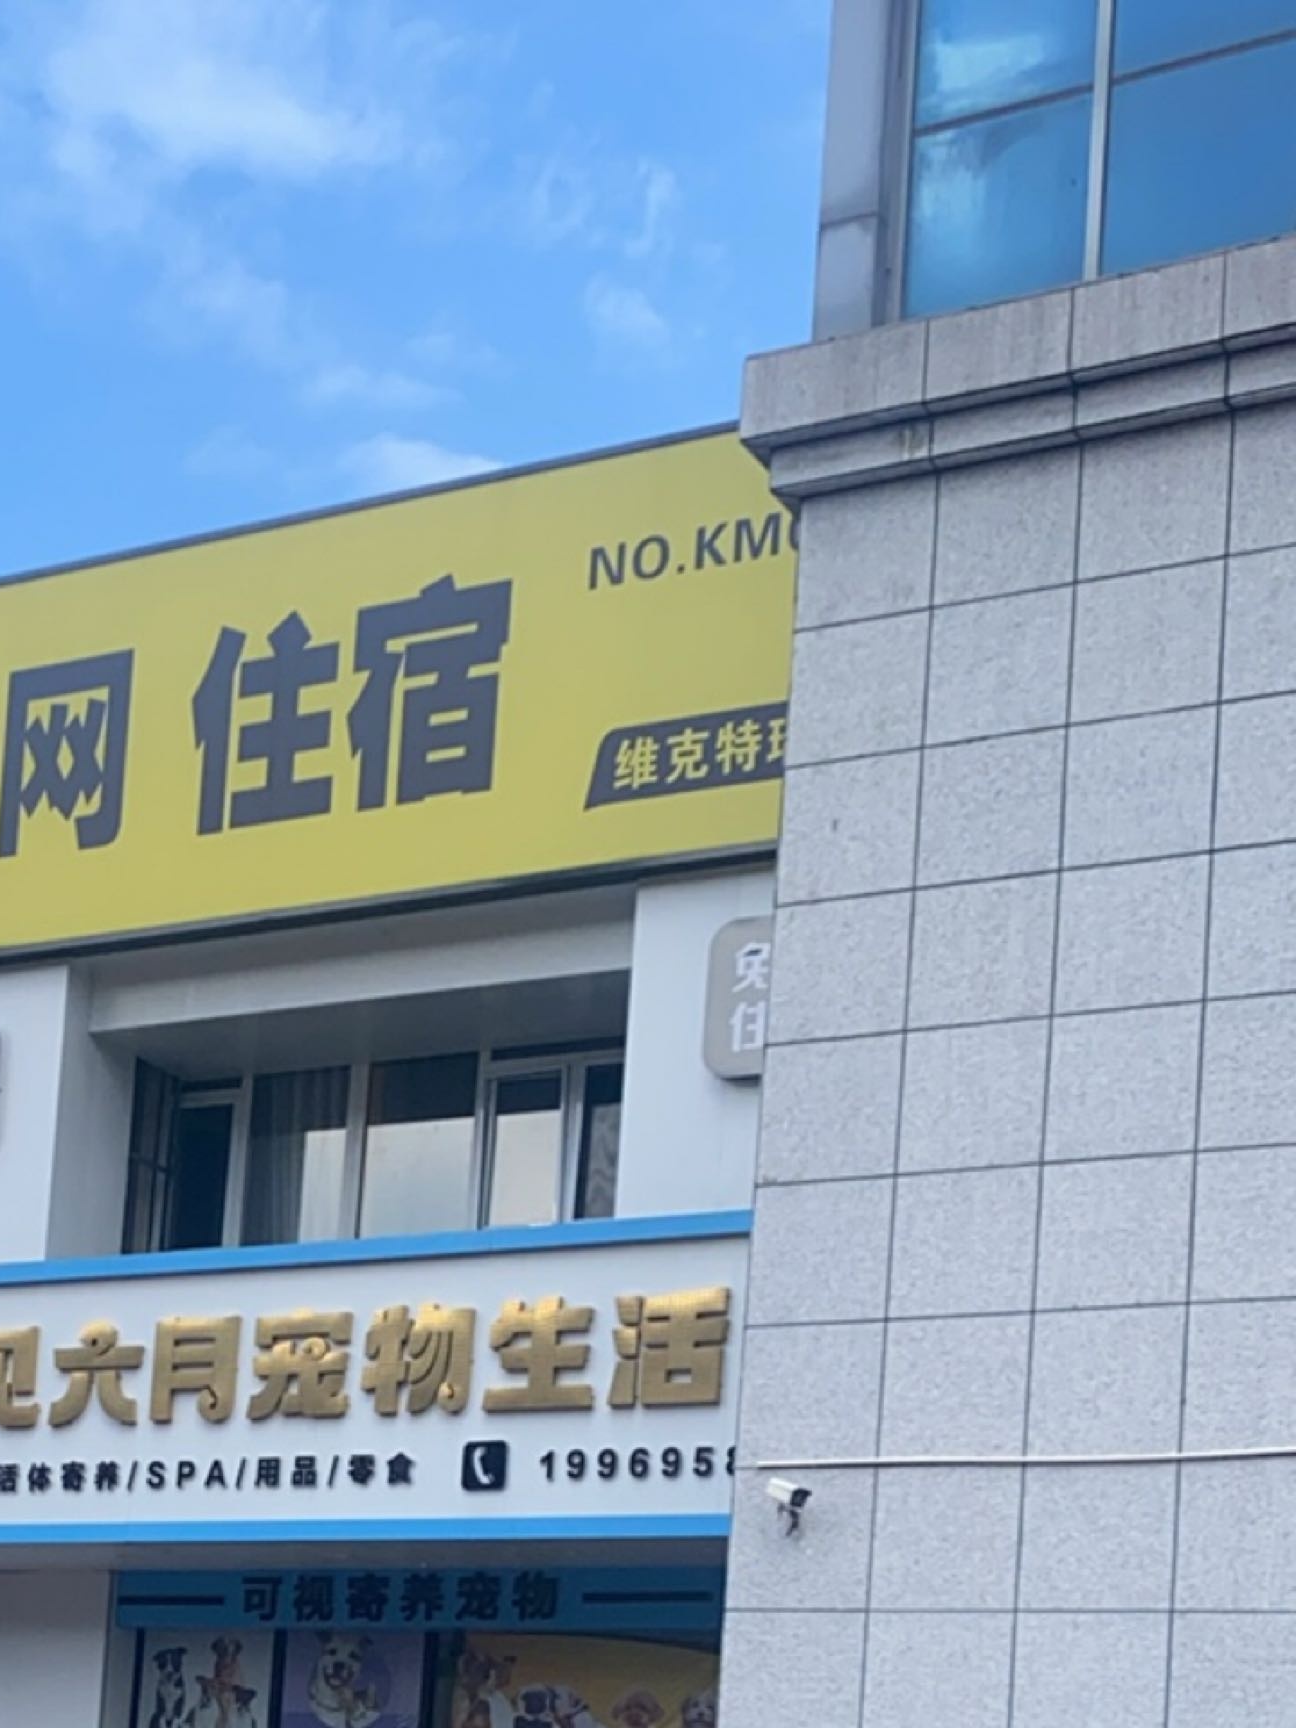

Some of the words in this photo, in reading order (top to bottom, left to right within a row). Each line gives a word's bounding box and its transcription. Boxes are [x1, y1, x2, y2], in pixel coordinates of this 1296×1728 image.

[192, 574, 513, 836] 住宿
[241, 1571, 561, 1622] 可视寄养宠物
